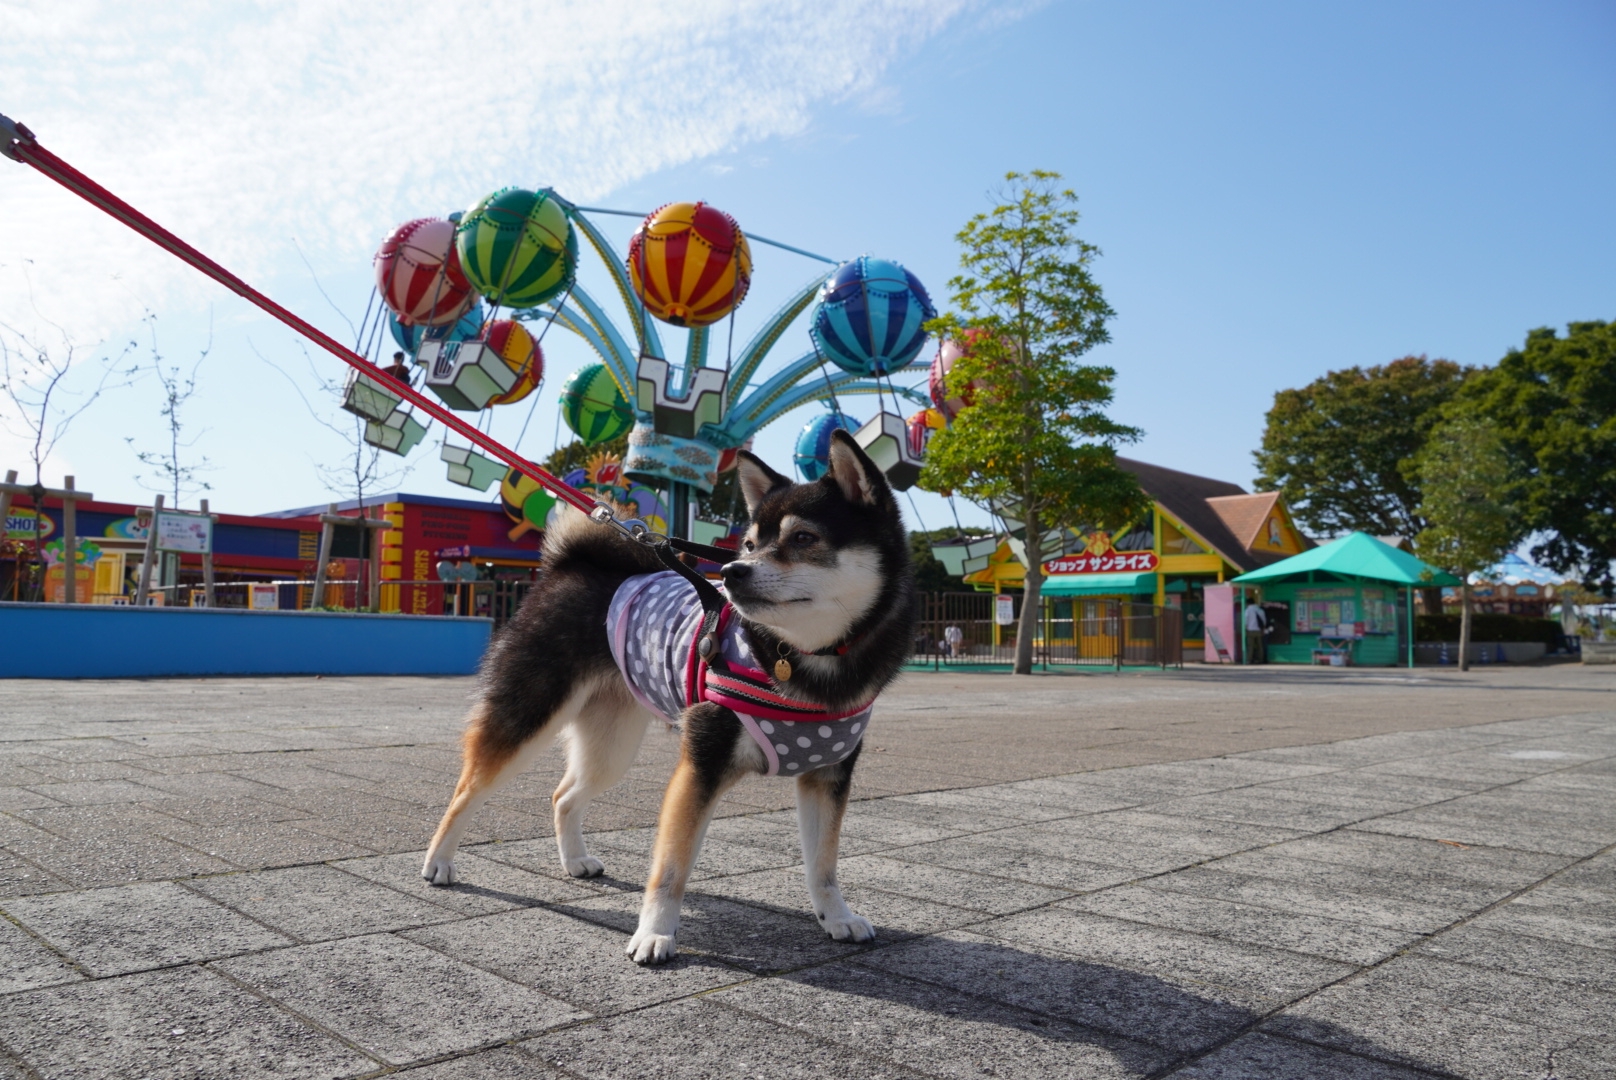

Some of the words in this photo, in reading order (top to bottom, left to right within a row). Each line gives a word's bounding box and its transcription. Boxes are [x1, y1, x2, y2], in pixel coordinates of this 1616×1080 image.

[5, 517, 37, 531] SHOT
[1048, 559, 1087, 572] ショップ
[1089, 554, 1151, 571] サンライズ
